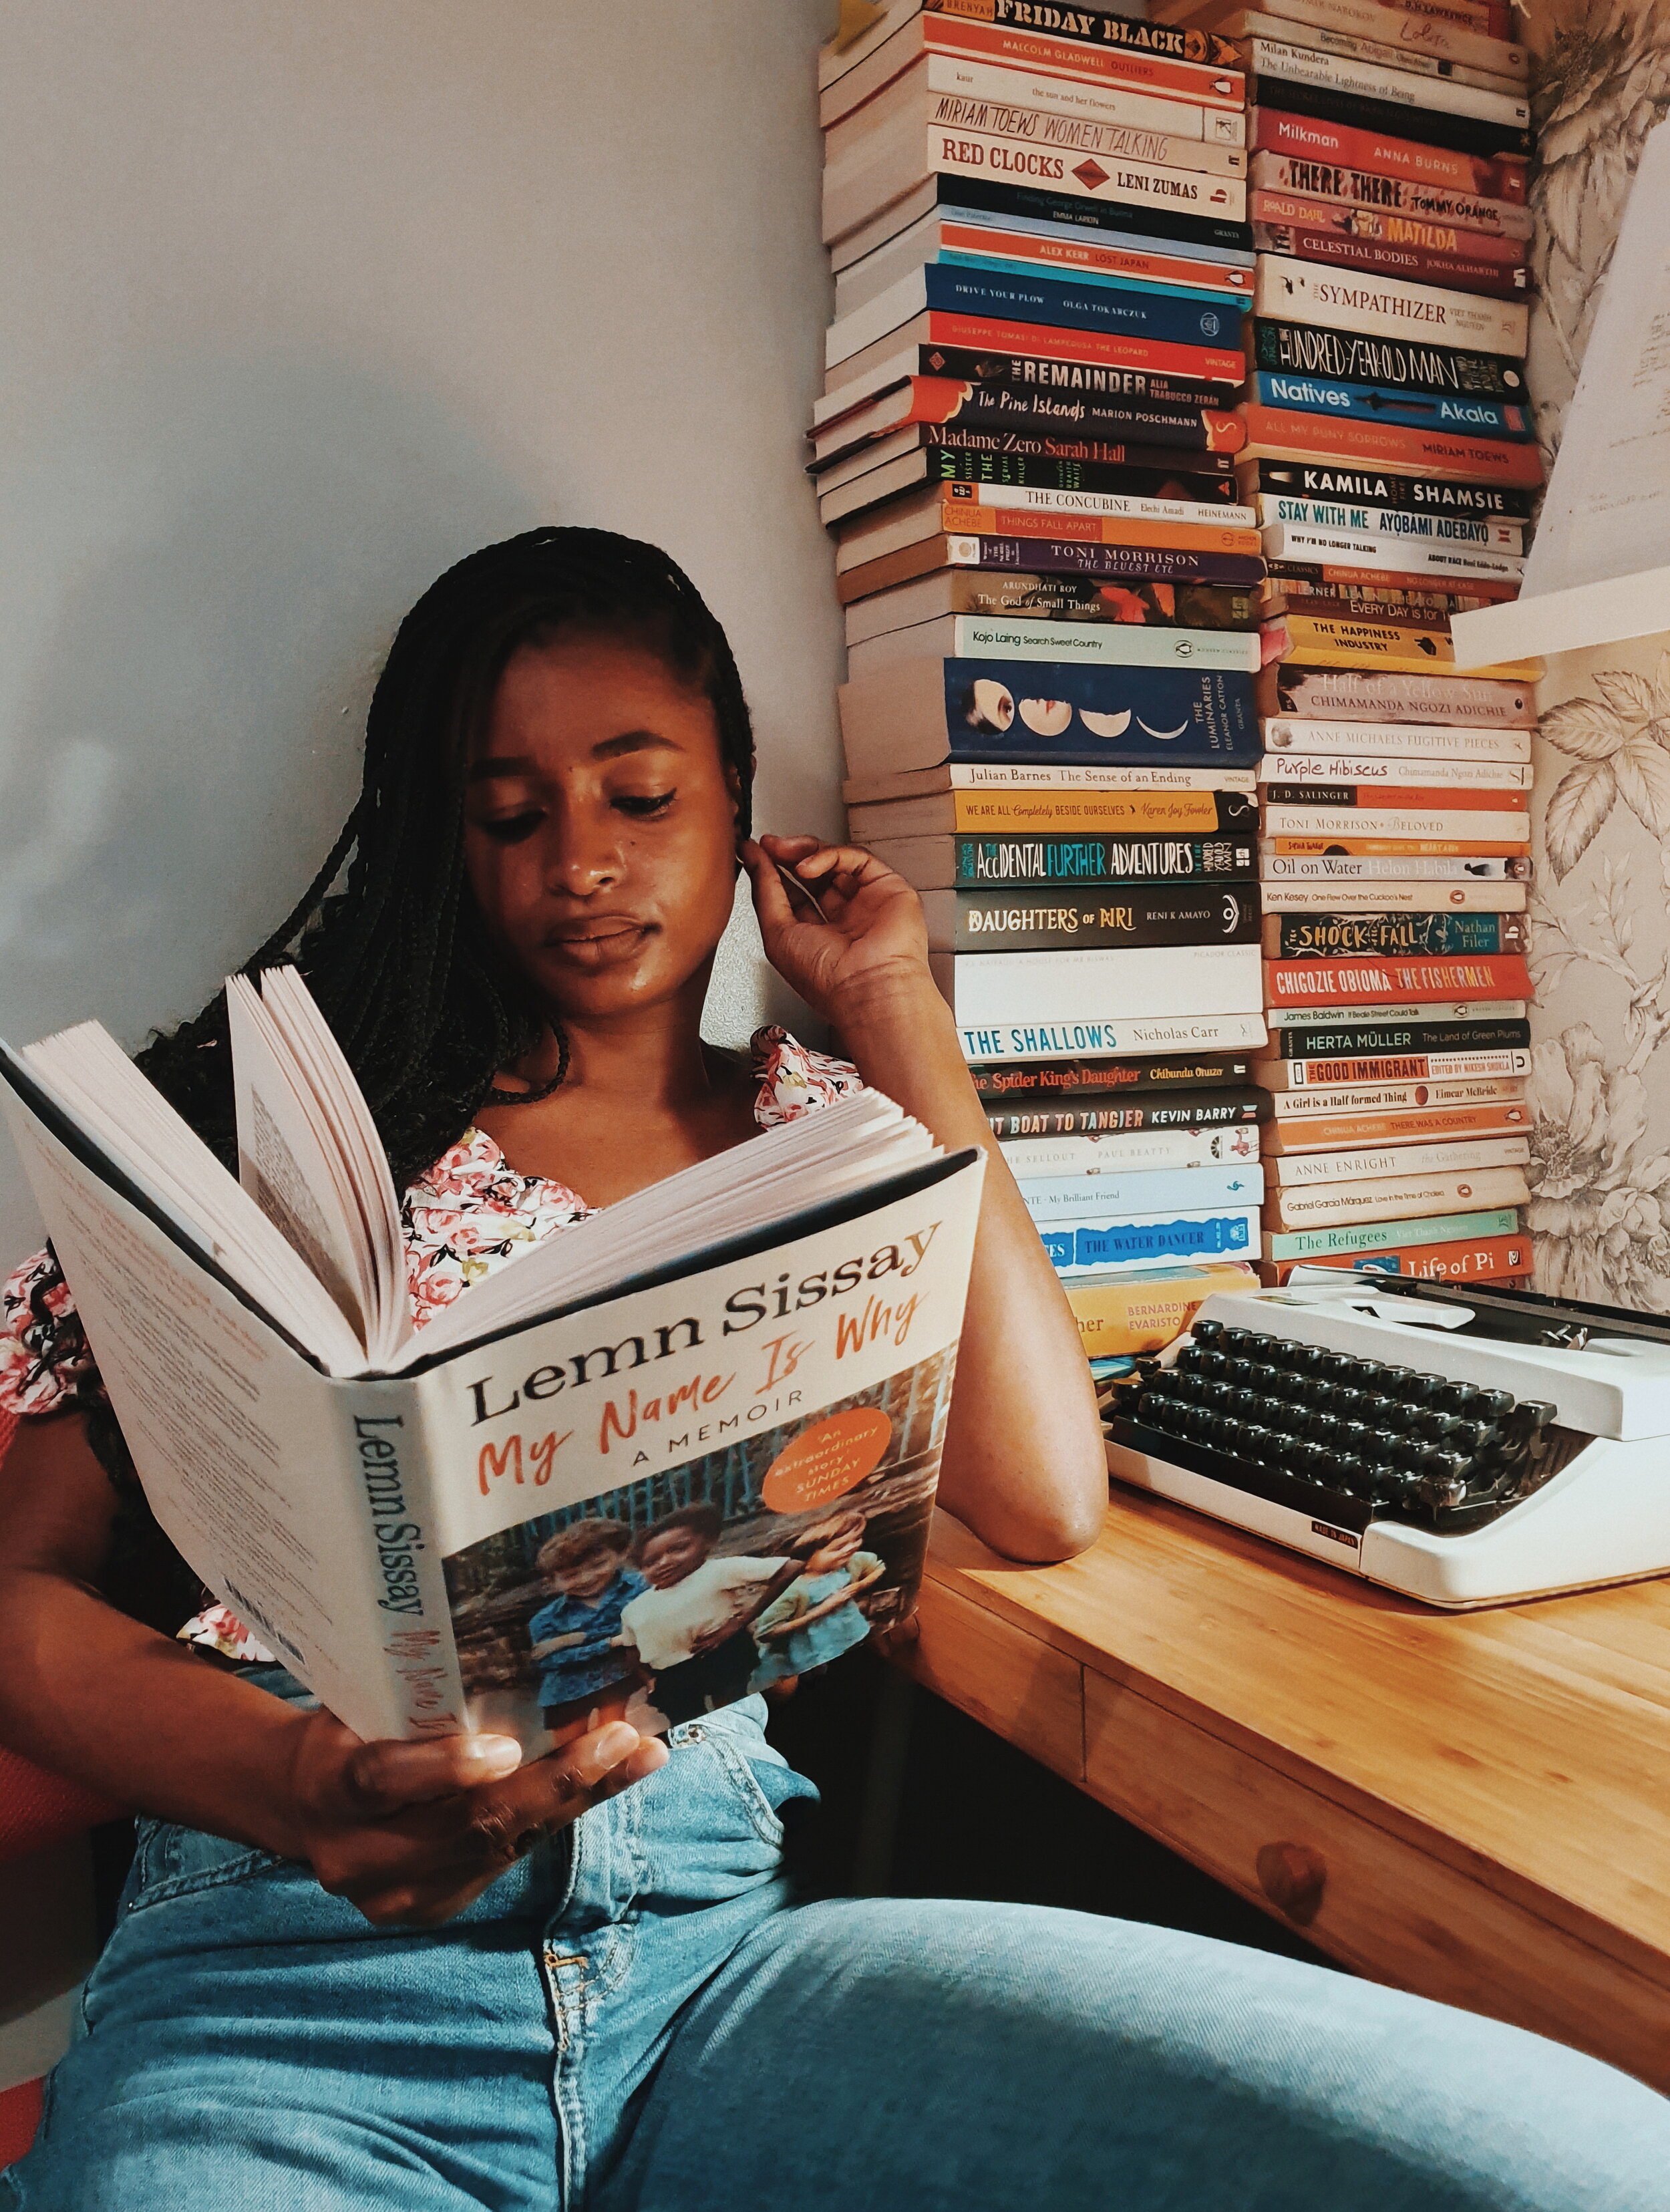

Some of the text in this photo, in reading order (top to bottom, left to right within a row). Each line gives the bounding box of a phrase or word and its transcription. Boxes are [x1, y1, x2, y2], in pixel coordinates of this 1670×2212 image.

[997, 0, 1184, 53] FRIDAY BLACK
[1003, 39, 1105, 67] MALCOLM GLADWELL
[1261, 43, 1329, 65] Milan Kundera
[935, 98, 1169, 161] MIRIAM TOEWS WOMEN TALKING
[1278, 122, 1459, 174] Milkman ANNA BURNS
[942, 138, 1198, 199] RED CLOCKS LENI ZUMAS
[1387, 218, 1458, 251] MATILDA
[1039, 245, 1149, 269] ALEX KERR LOST JAPAN
[1303, 237, 1418, 265] CELESTIAL BODIES
[956, 285, 1147, 319] DRIVE YOUR PLOW OLGA TOKARCZUK
[1319, 284, 1446, 324] SYMPATHIZER
[1024, 361, 1146, 396] REMAINDER
[979, 389, 1197, 428] The Pine Islands MARION POSCHMANN
[1271, 379, 1498, 425] Natives Akala
[929, 425, 1126, 462] Madame Zero Sarah Hall
[1304, 471, 1504, 510] KAMILA SHAMSIE
[1025, 490, 1246, 520] THE CONCUBINE HEINEMANN
[1279, 500, 1369, 528] STAY WITH ME
[1001, 515, 1097, 532] THINGS FALL APART
[1051, 545, 1200, 567] TONI MORRISON
[1002, 581, 1077, 593] ARUNDHATI ROY
[978, 593, 997, 605] The
[1001, 596, 1021, 607] God
[1037, 598, 1065, 609] Small
[1068, 599, 1100, 612] Things
[1313, 622, 1400, 640] THE HAPPINESS
[1335, 639, 1388, 651] INDUSTRY
[1202, 675, 1220, 749] LUMINARIES
[1311, 695, 1506, 716] CHIMAMANDA NGOZI ADICHIE
[969, 768, 1191, 786] Julian Barnes The Sense of an Ending
[1277, 758, 1387, 781] Purple Hibiscus
[966, 804, 1212, 819] WE ARE ALL Completely BESIDE OURSELVES Karen Joy Fowler
[1280, 818, 1377, 830] TONI MORRISON
[1047, 843, 1106, 877] FURTHER
[1111, 842, 1193, 875] ADVENTURES
[1273, 859, 1362, 875] Oil on Water
[1267, 893, 1308, 903] Ken Kesey
[968, 907, 1210, 934] DAUGHTERS RENI K AMAYO
[1299, 925, 1419, 948] SHOCK FALL
[1277, 966, 1495, 995] CHIGOZIE OBIOMA THE FISHERMEN
[1284, 1011, 1344, 1021] James Baldwin
[964, 1024, 1218, 1055] THE SHALLOWS Nicholas Carr
[1306, 1032, 1411, 1050] HERTA MÜLLER
[993, 1068, 1140, 1092] Spider King's Daughter
[1317, 1059, 1426, 1080] GOOD IMMIGRANT
[1011, 1116, 1047, 1134] BOAT
[1055, 1113, 1073, 1131] TO
[1080, 1110, 1143, 1130] TANGIER
[1151, 1109, 1190, 1124] KEVIN
[1196, 1107, 1236, 1120] BARRY
[1295, 1156, 1397, 1176] ANNE ENRIGHT
[1049, 1195, 1061, 1204] My
[1063, 1193, 1093, 1203] Brilliant
[1096, 1191, 1120, 1201] Friend
[1085, 1241, 1107, 1254] THE
[1114, 1237, 1154, 1251] WATER
[1158, 1232, 1204, 1248] DANCER
[1295, 1231, 1387, 1251] The Refugees
[1409, 1253, 1494, 1277] Life of Pi
[1128, 1301, 1197, 1316] BERNARDINE
[467, 1221, 943, 1428] Lemn Sissay
[1129, 1317, 1180, 1329] EVARISTO
[478, 1289, 931, 1496] My Name Is Why
[633, 1390, 804, 1468] A MEMOIR
[775, 1426, 878, 1476] extraordinary
[797, 1458, 860, 1492] SUNDAY
[806, 1476, 850, 1501] TIMES
[353, 1414, 426, 1617] Lemn Sissay
[1339, 1534, 1354, 1545] JAPAN
